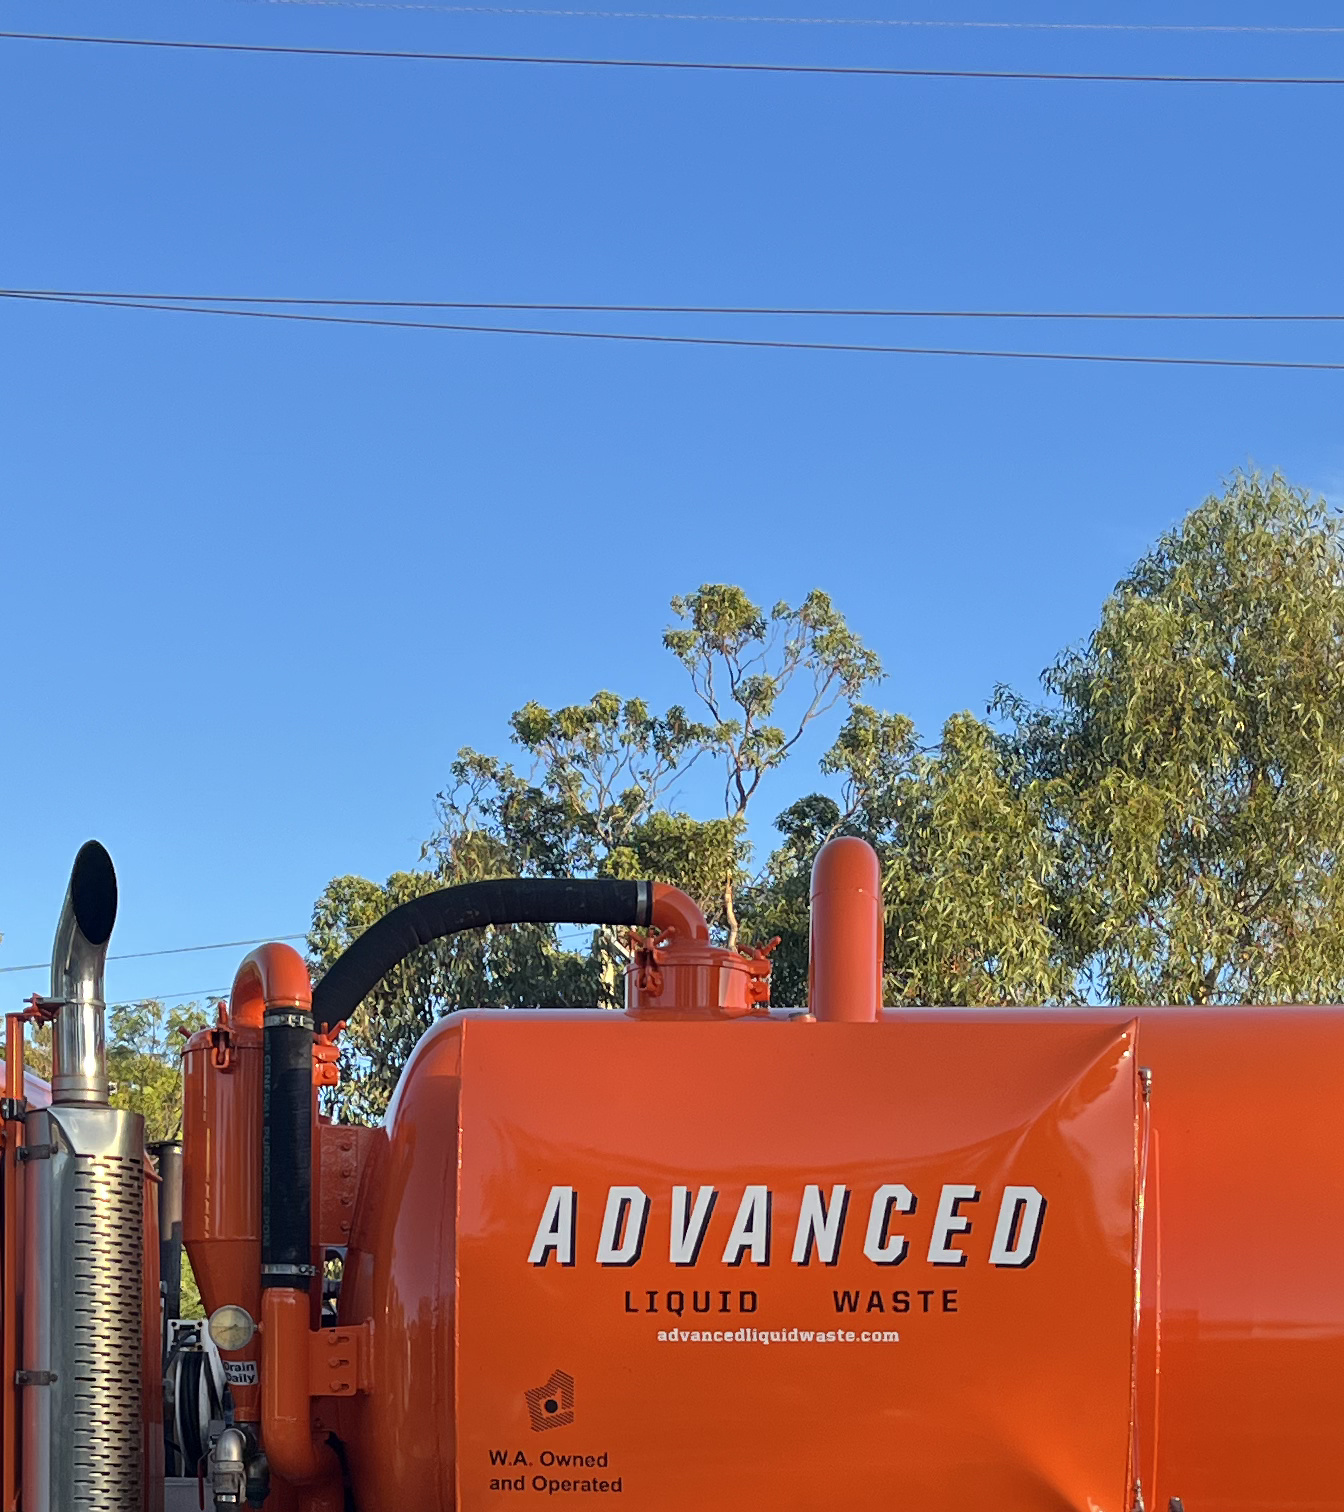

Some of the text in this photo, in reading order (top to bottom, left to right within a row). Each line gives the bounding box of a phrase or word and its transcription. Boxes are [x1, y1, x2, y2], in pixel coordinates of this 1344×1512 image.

[528, 1184, 1047, 1268] ADVANCED
[624, 1289, 960, 1315] LIQUID WASTE
[656, 1327, 901, 1346] advancedliquidwaste.com
[489, 1449, 609, 1468] W.A. Owned
[489, 1474, 623, 1496] and Operated
